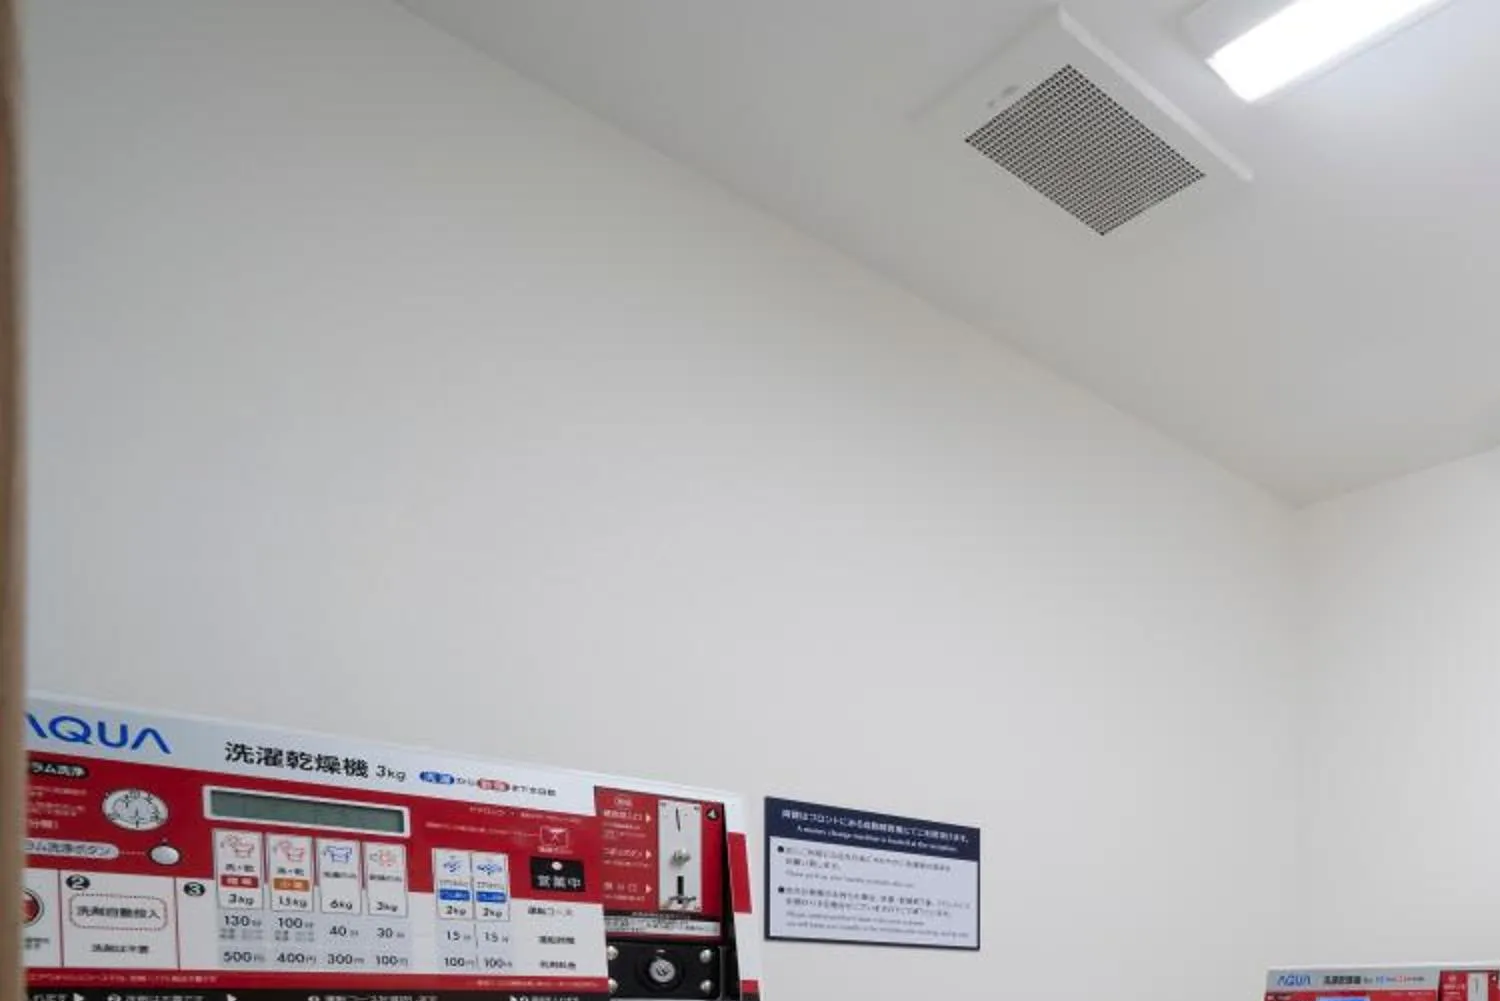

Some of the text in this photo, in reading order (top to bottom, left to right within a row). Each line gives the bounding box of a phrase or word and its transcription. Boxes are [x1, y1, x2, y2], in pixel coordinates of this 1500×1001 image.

[224, 740, 406, 783] 洗濯乾燥機 3kg
